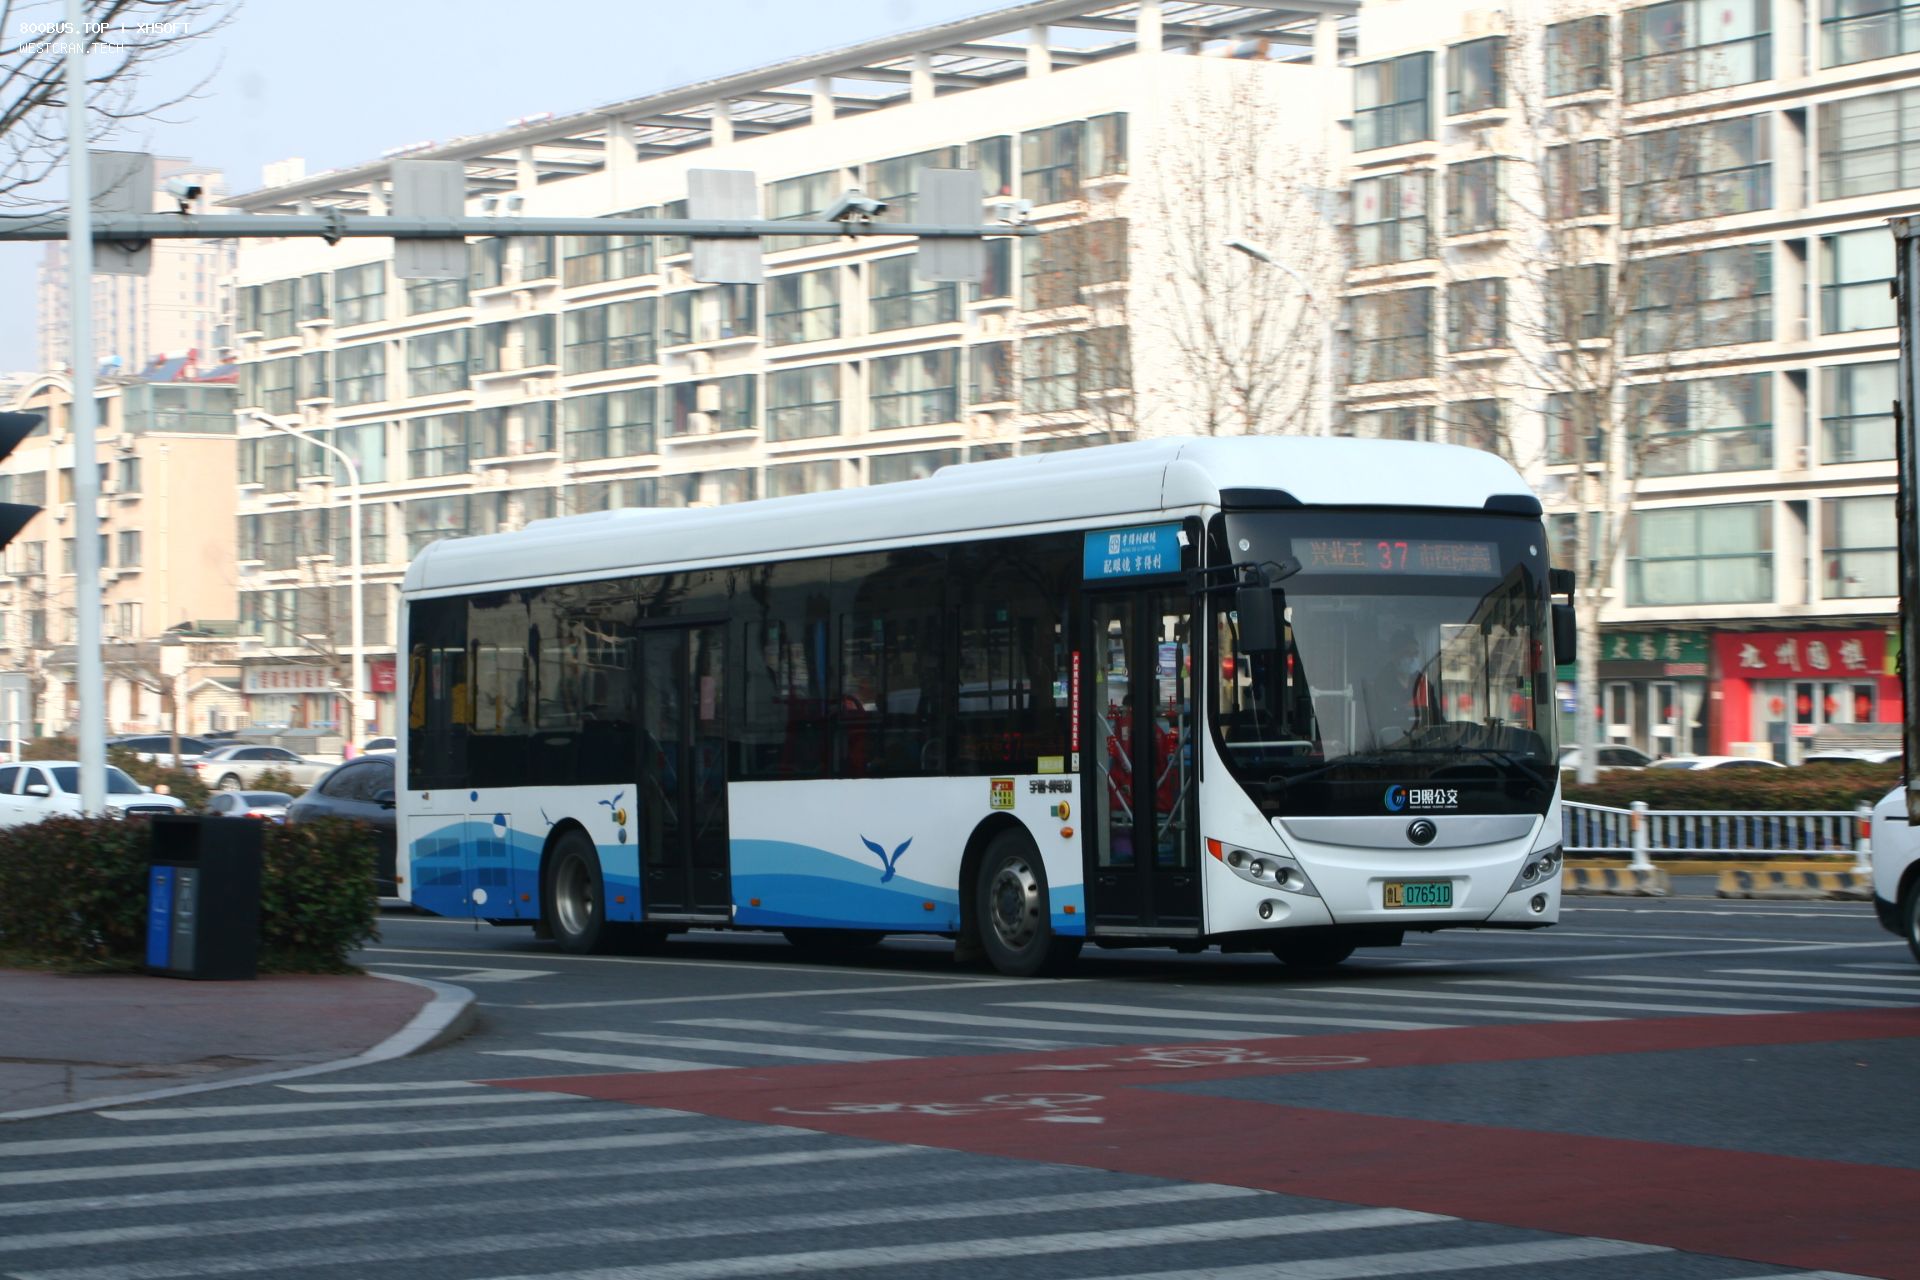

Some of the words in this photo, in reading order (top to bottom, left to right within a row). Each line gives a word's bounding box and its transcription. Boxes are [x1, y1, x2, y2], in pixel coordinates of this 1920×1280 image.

[1377, 541, 1409, 569] 37
[1409, 788, 1458, 804] 日照公交
